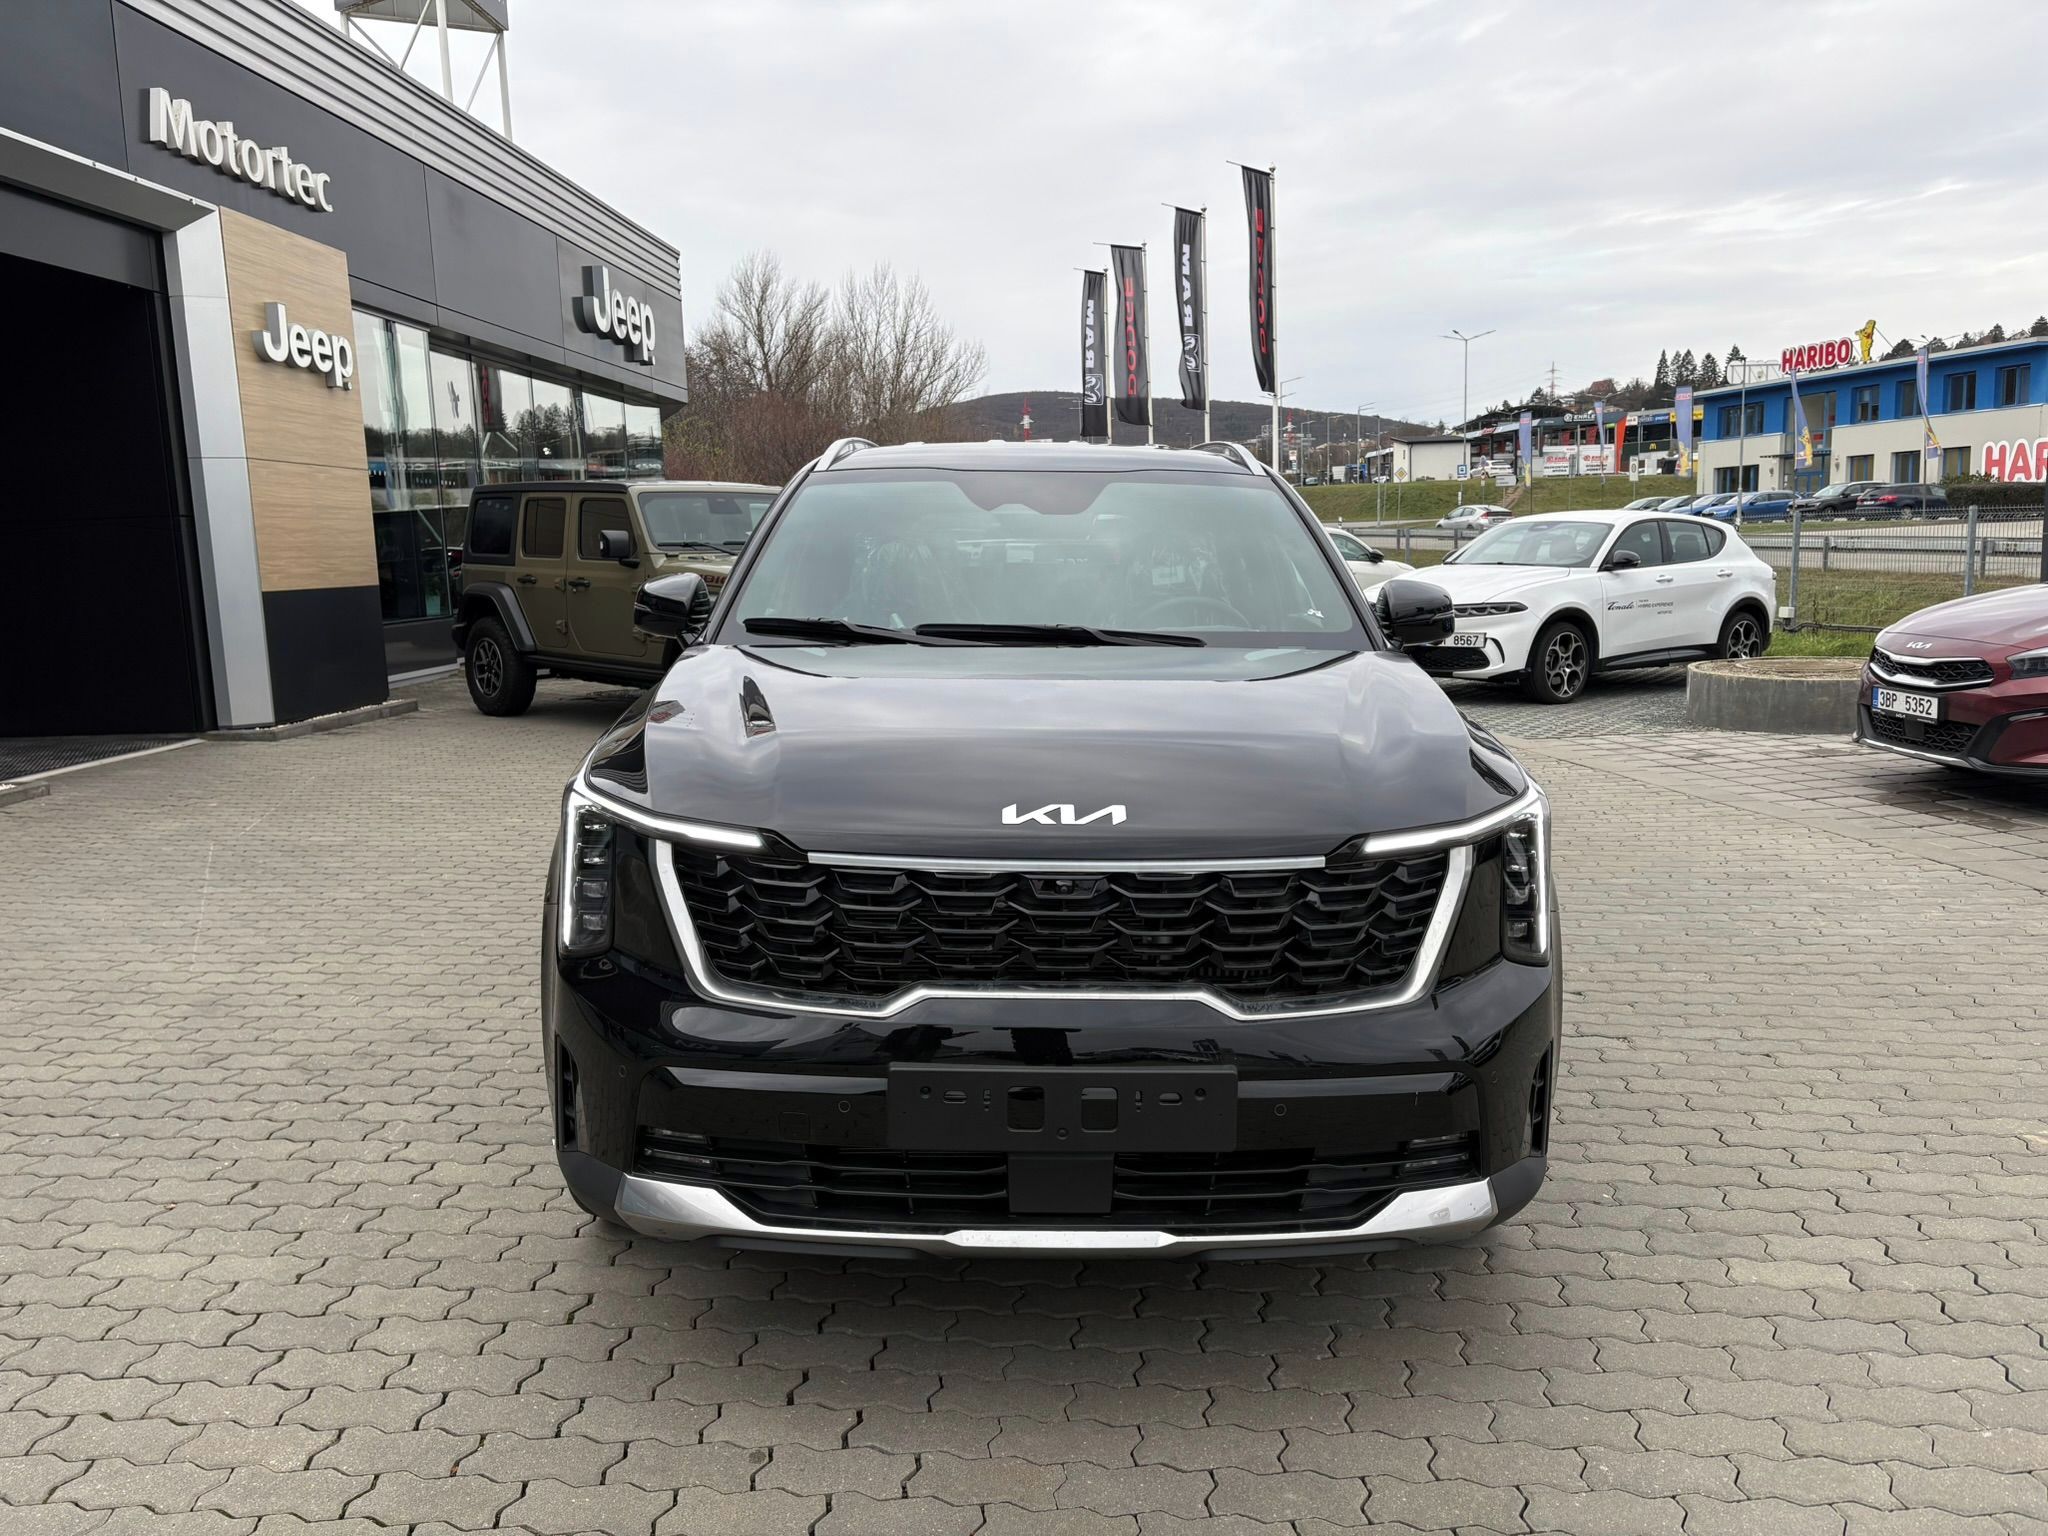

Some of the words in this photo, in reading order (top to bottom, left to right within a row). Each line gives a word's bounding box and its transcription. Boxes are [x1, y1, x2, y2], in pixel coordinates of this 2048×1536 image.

[149, 87, 333, 212] Motortec
[576, 265, 655, 365] Jeep
[254, 302, 353, 389] Jeep
[1781, 337, 1853, 373] HARIBO
[1453, 635, 1479, 646] 8567
[1880, 691, 1897, 708] 3BP
[1905, 695, 1932, 716] 5352
[1002, 803, 1127, 825] KIA
